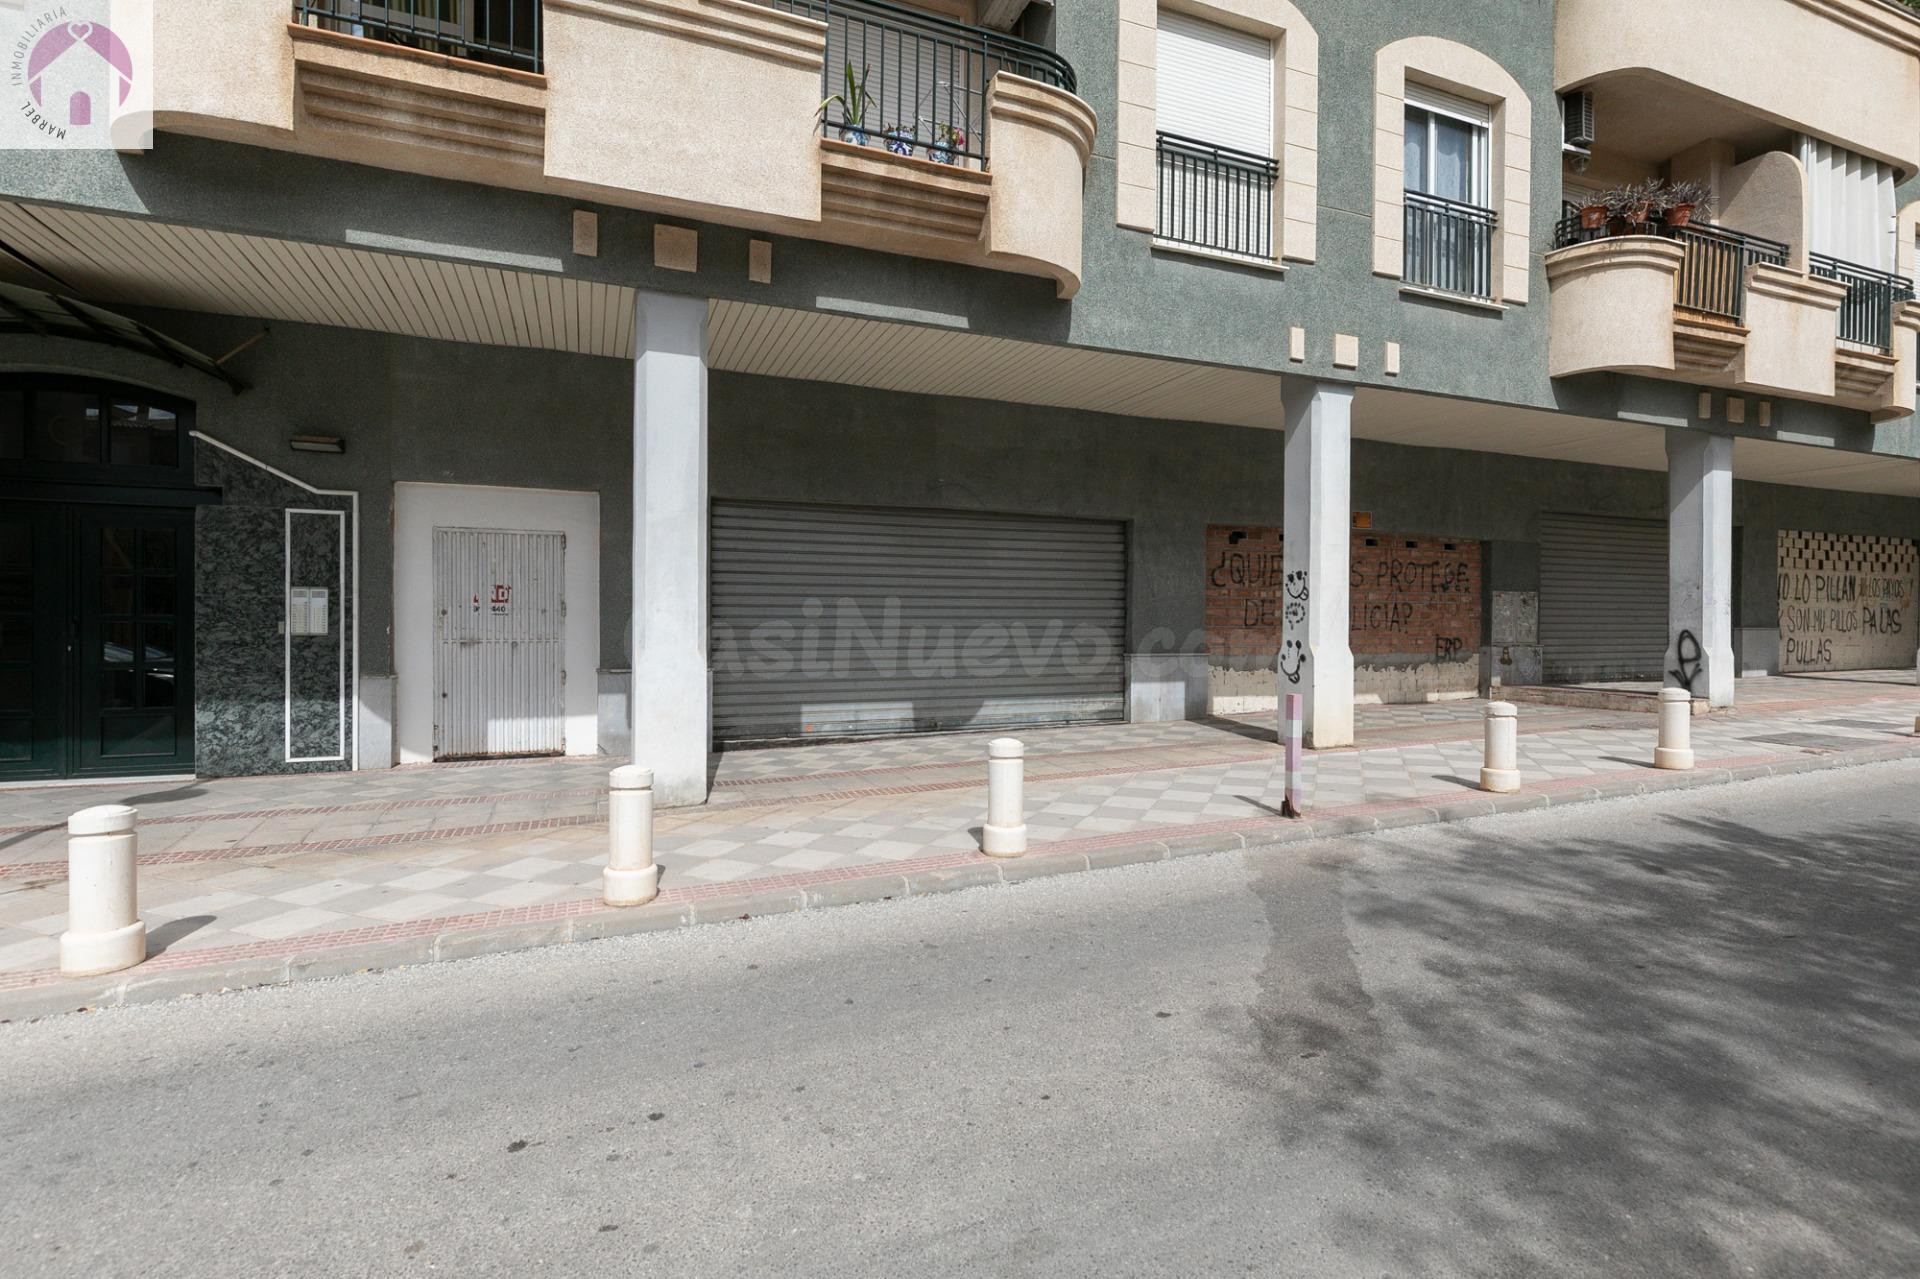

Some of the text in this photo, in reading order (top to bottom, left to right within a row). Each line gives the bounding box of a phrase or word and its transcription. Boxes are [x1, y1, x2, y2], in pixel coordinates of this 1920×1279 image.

[1211, 551, 1283, 588] ¿QUIE
[1815, 575, 1857, 604] PILLAN
[1244, 598, 1276, 627] DE
[1785, 637, 1833, 666] PULLAS
